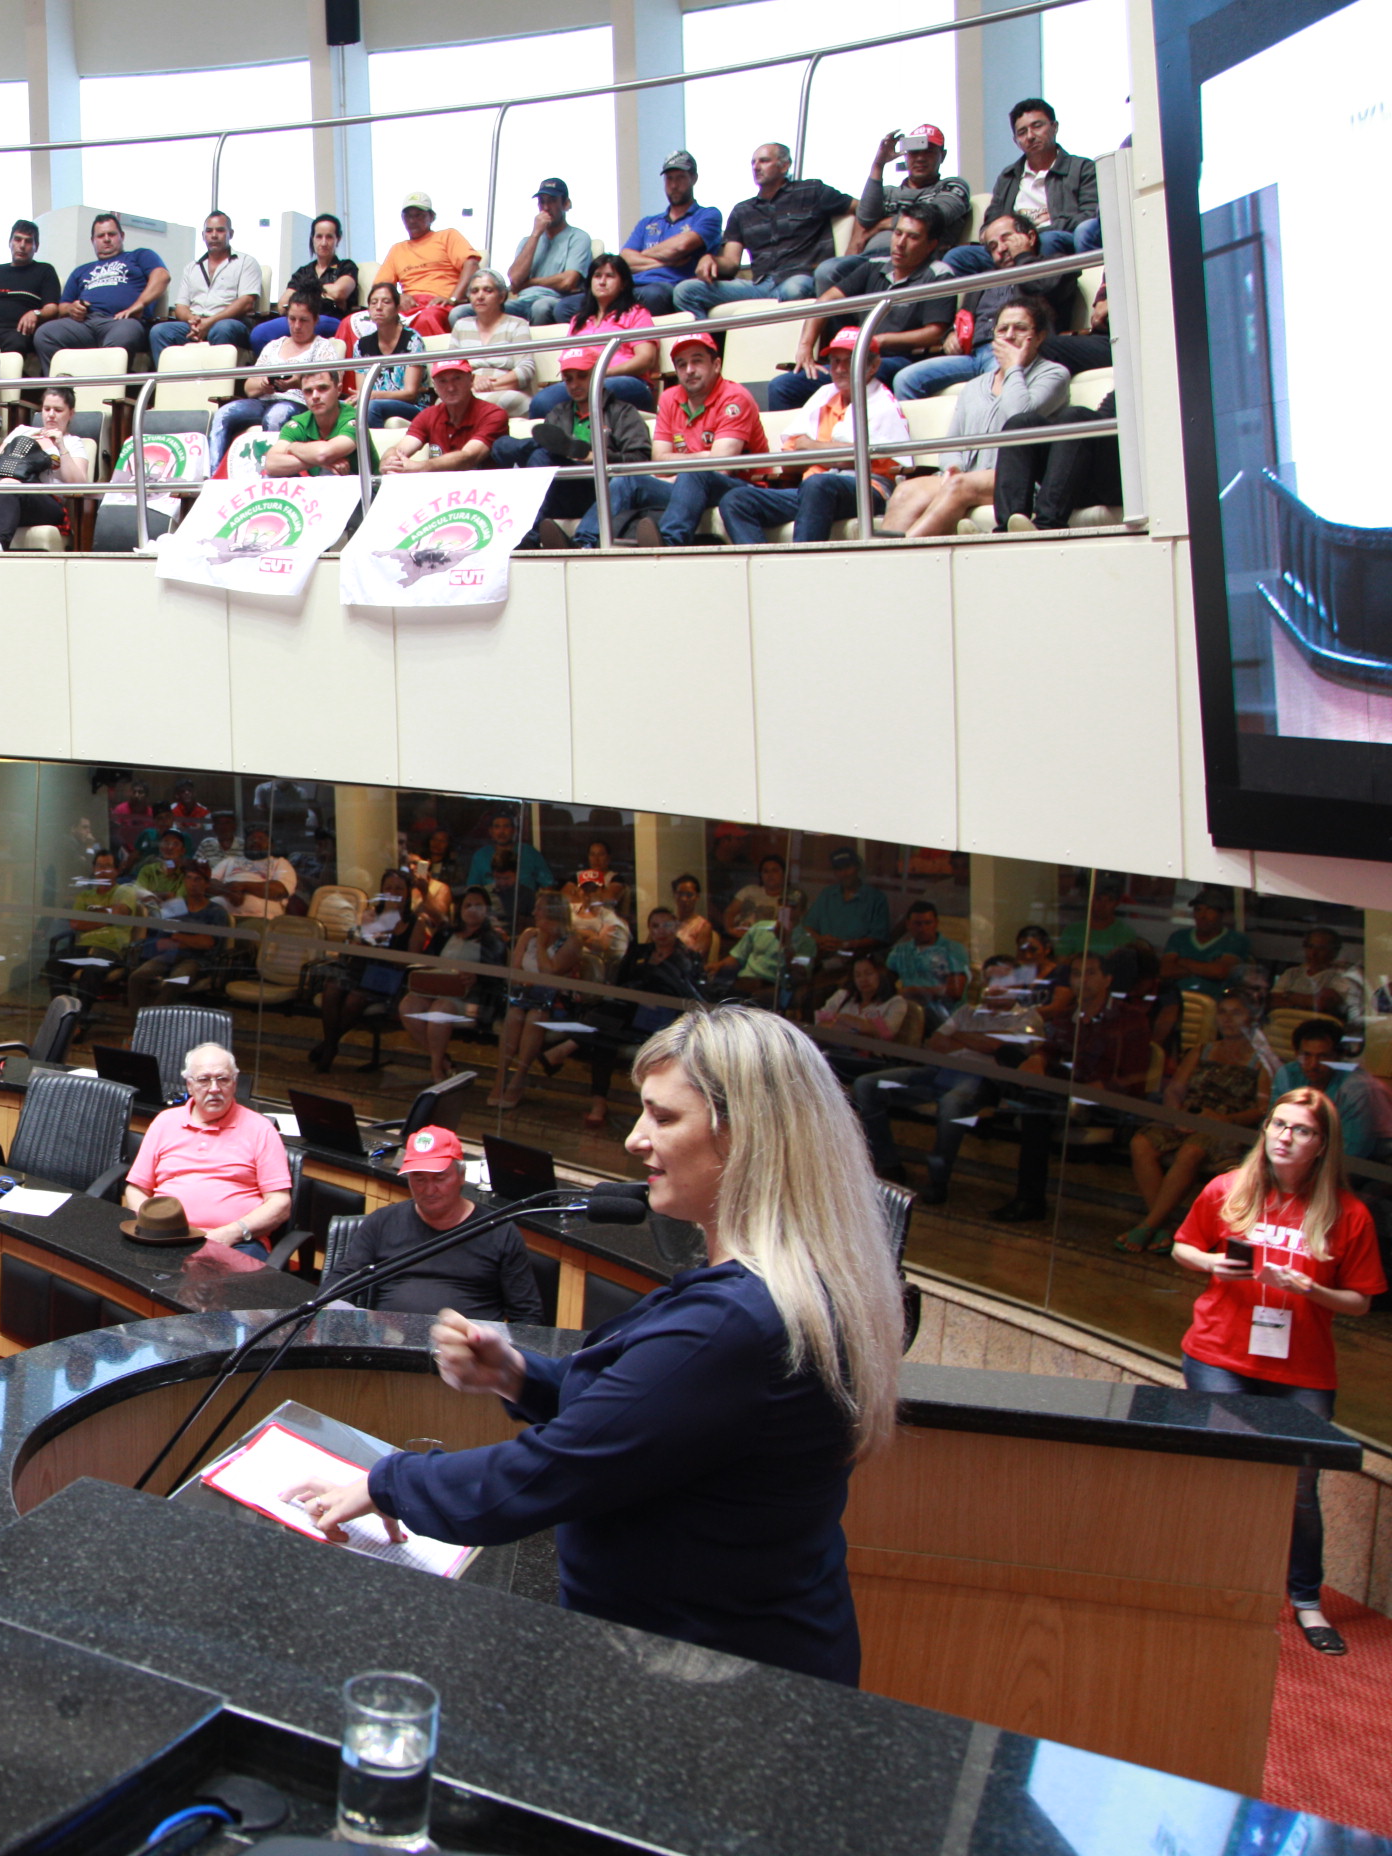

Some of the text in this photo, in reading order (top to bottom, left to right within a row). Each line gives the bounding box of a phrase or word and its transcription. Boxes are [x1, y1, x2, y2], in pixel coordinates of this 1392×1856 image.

[217, 480, 323, 526] FETRAF-SC
[229, 501, 303, 533] AGRICULTURA FAMILIAR
[397, 488, 513, 534] FETRAF-SC
[411, 511, 492, 542] AGRICULTURA FAMILIAR
[449, 570, 484, 585] CUT
[1246, 1222, 1303, 1250] CUT
